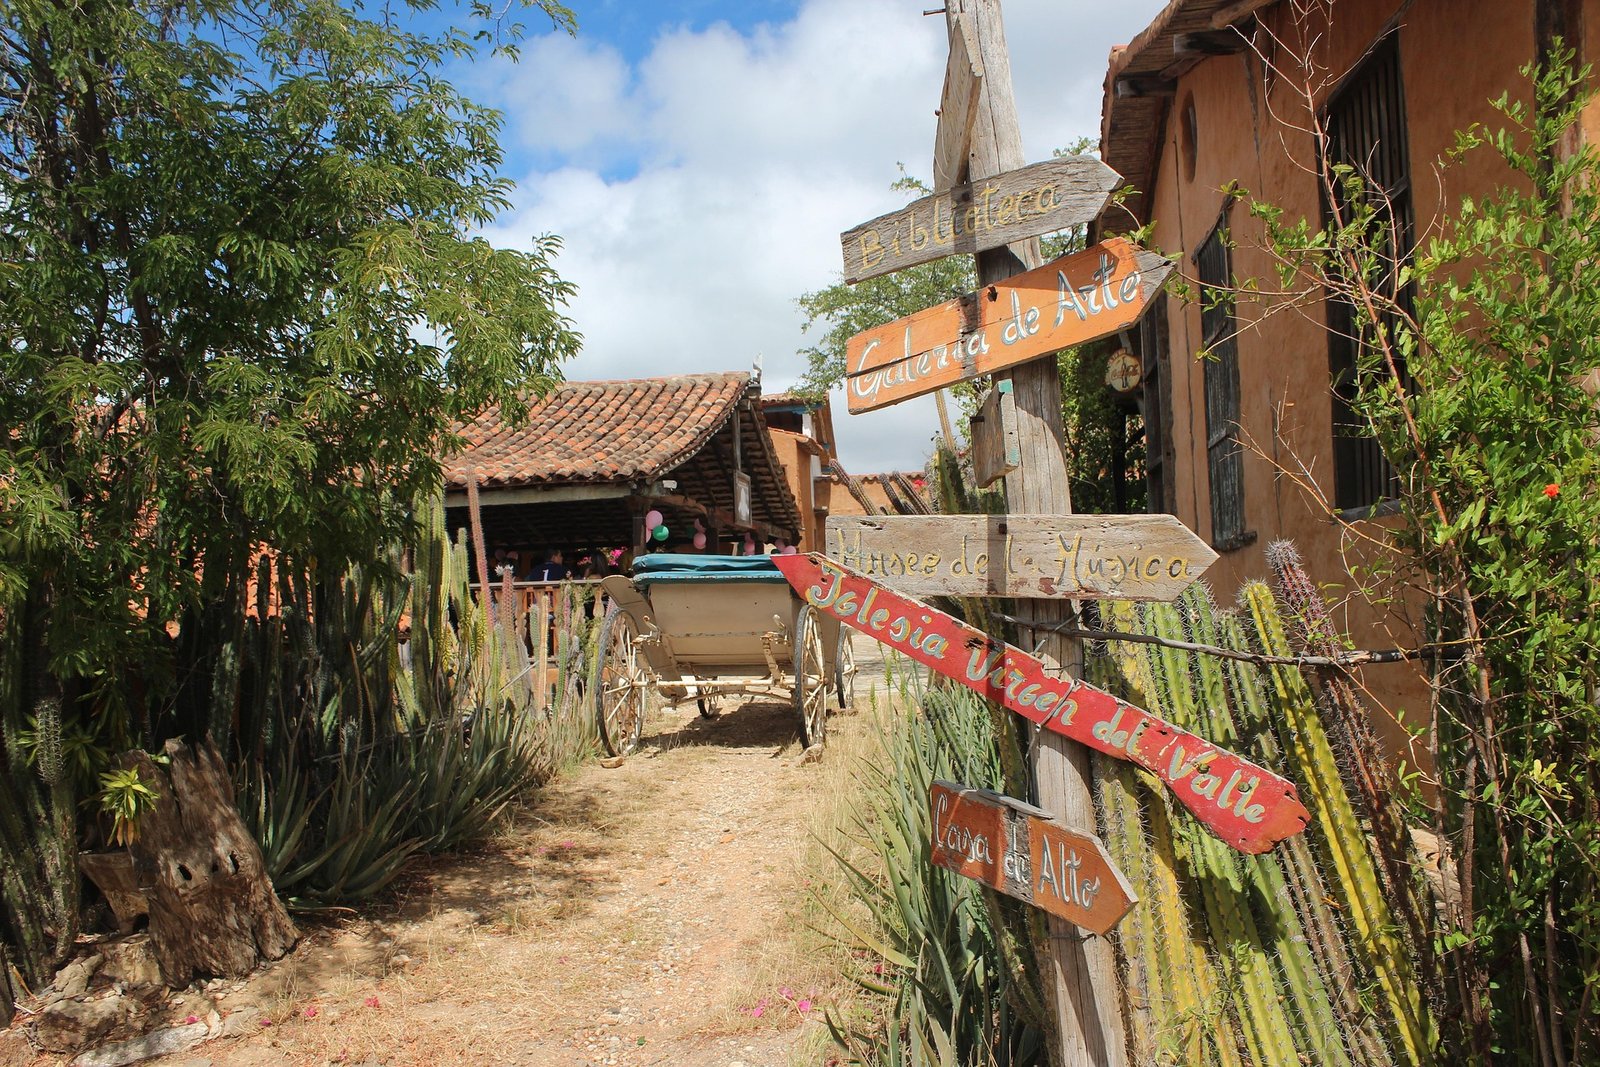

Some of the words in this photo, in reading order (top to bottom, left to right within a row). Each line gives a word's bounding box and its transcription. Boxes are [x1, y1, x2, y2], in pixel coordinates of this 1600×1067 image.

[857, 181, 1062, 273] Biblioteca
[1001, 288, 1040, 345] de
[1053, 251, 1142, 328] Arte
[543, 569, 549, 582] 1
[836, 528, 941, 578] Museo
[951, 534, 989, 579] de
[964, 646, 1080, 727] Virgen
[1091, 704, 1150, 756] del
[1167, 744, 1267, 824] Valle
[934, 792, 993, 865] Casa
[1003, 822, 1030, 885] de
[1037, 834, 1100, 911] Alto
